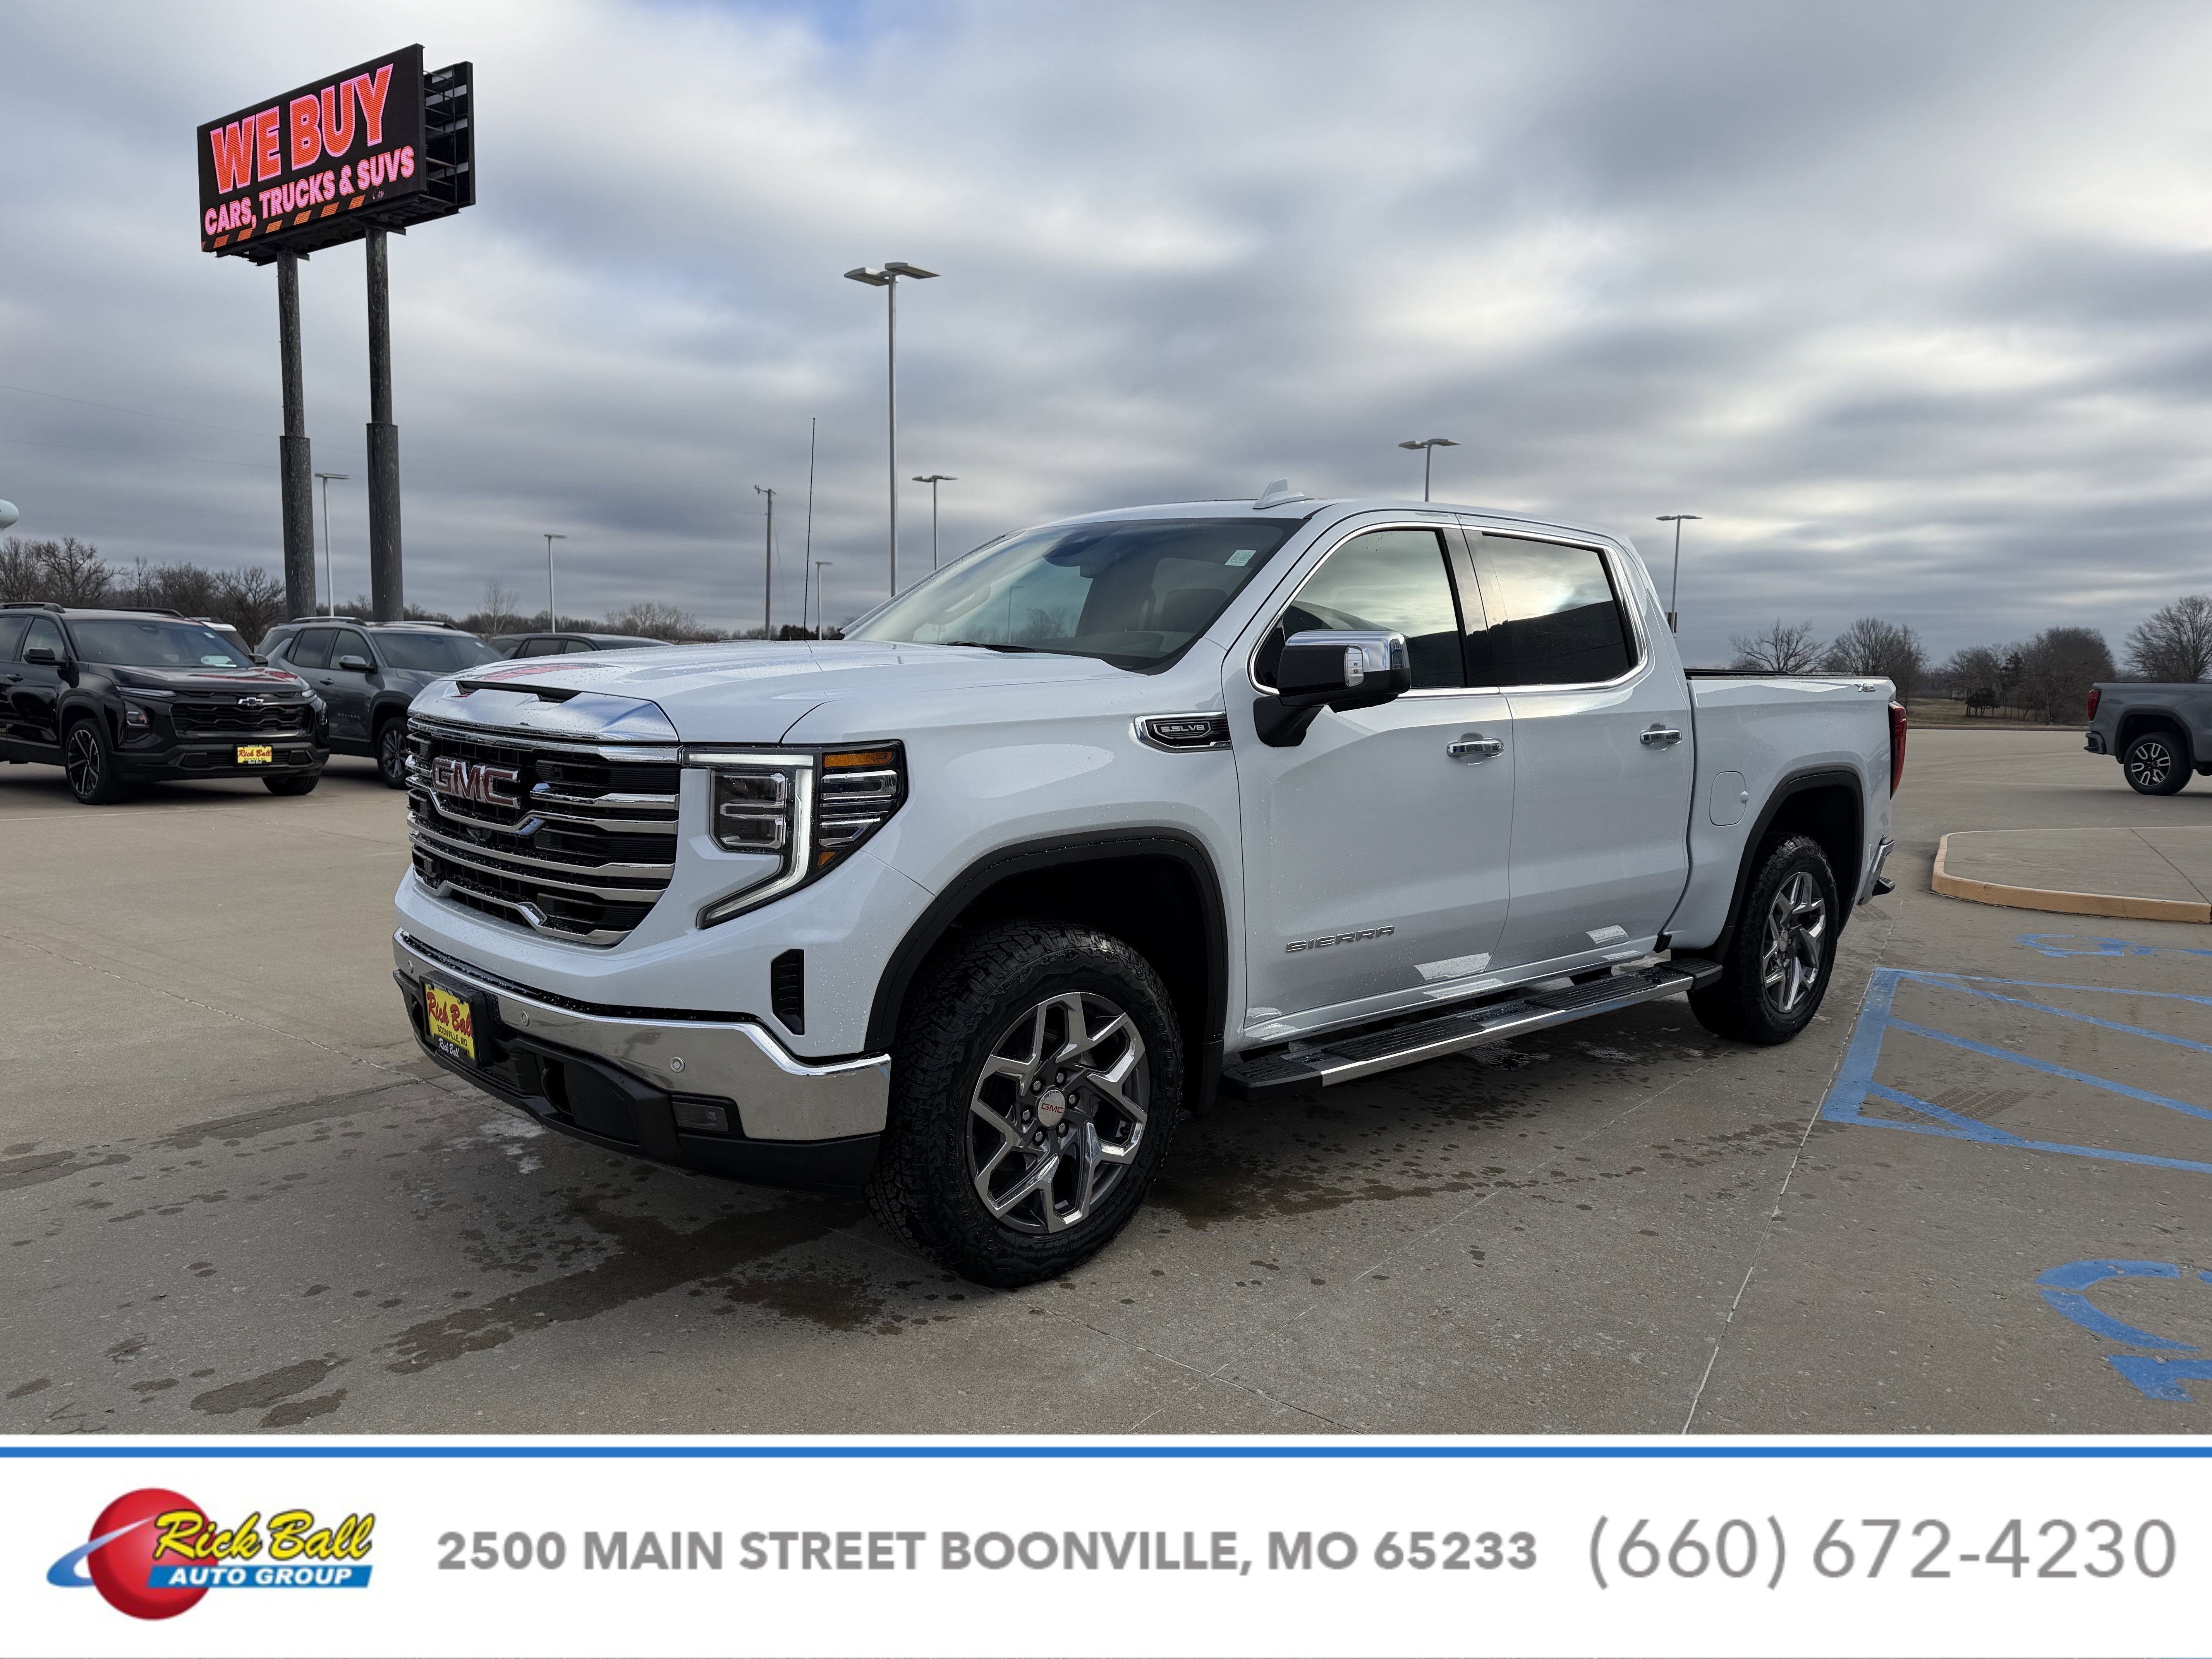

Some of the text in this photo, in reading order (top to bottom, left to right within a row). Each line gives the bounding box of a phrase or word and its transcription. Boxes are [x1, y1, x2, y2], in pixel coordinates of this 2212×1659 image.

[210, 63, 394, 194] WE BUY
[204, 145, 415, 235] CARS, TRUCKS & SUVS
[239, 749, 272, 757] Rick Ball
[433, 757, 521, 809] GMC
[1286, 925, 1395, 952] SIERRA
[427, 991, 449, 1026] Rick
[439, 1038, 459, 1058] Rick Ball
[460, 1036, 467, 1046] MO
[1041, 1103, 1064, 1114] GMC
